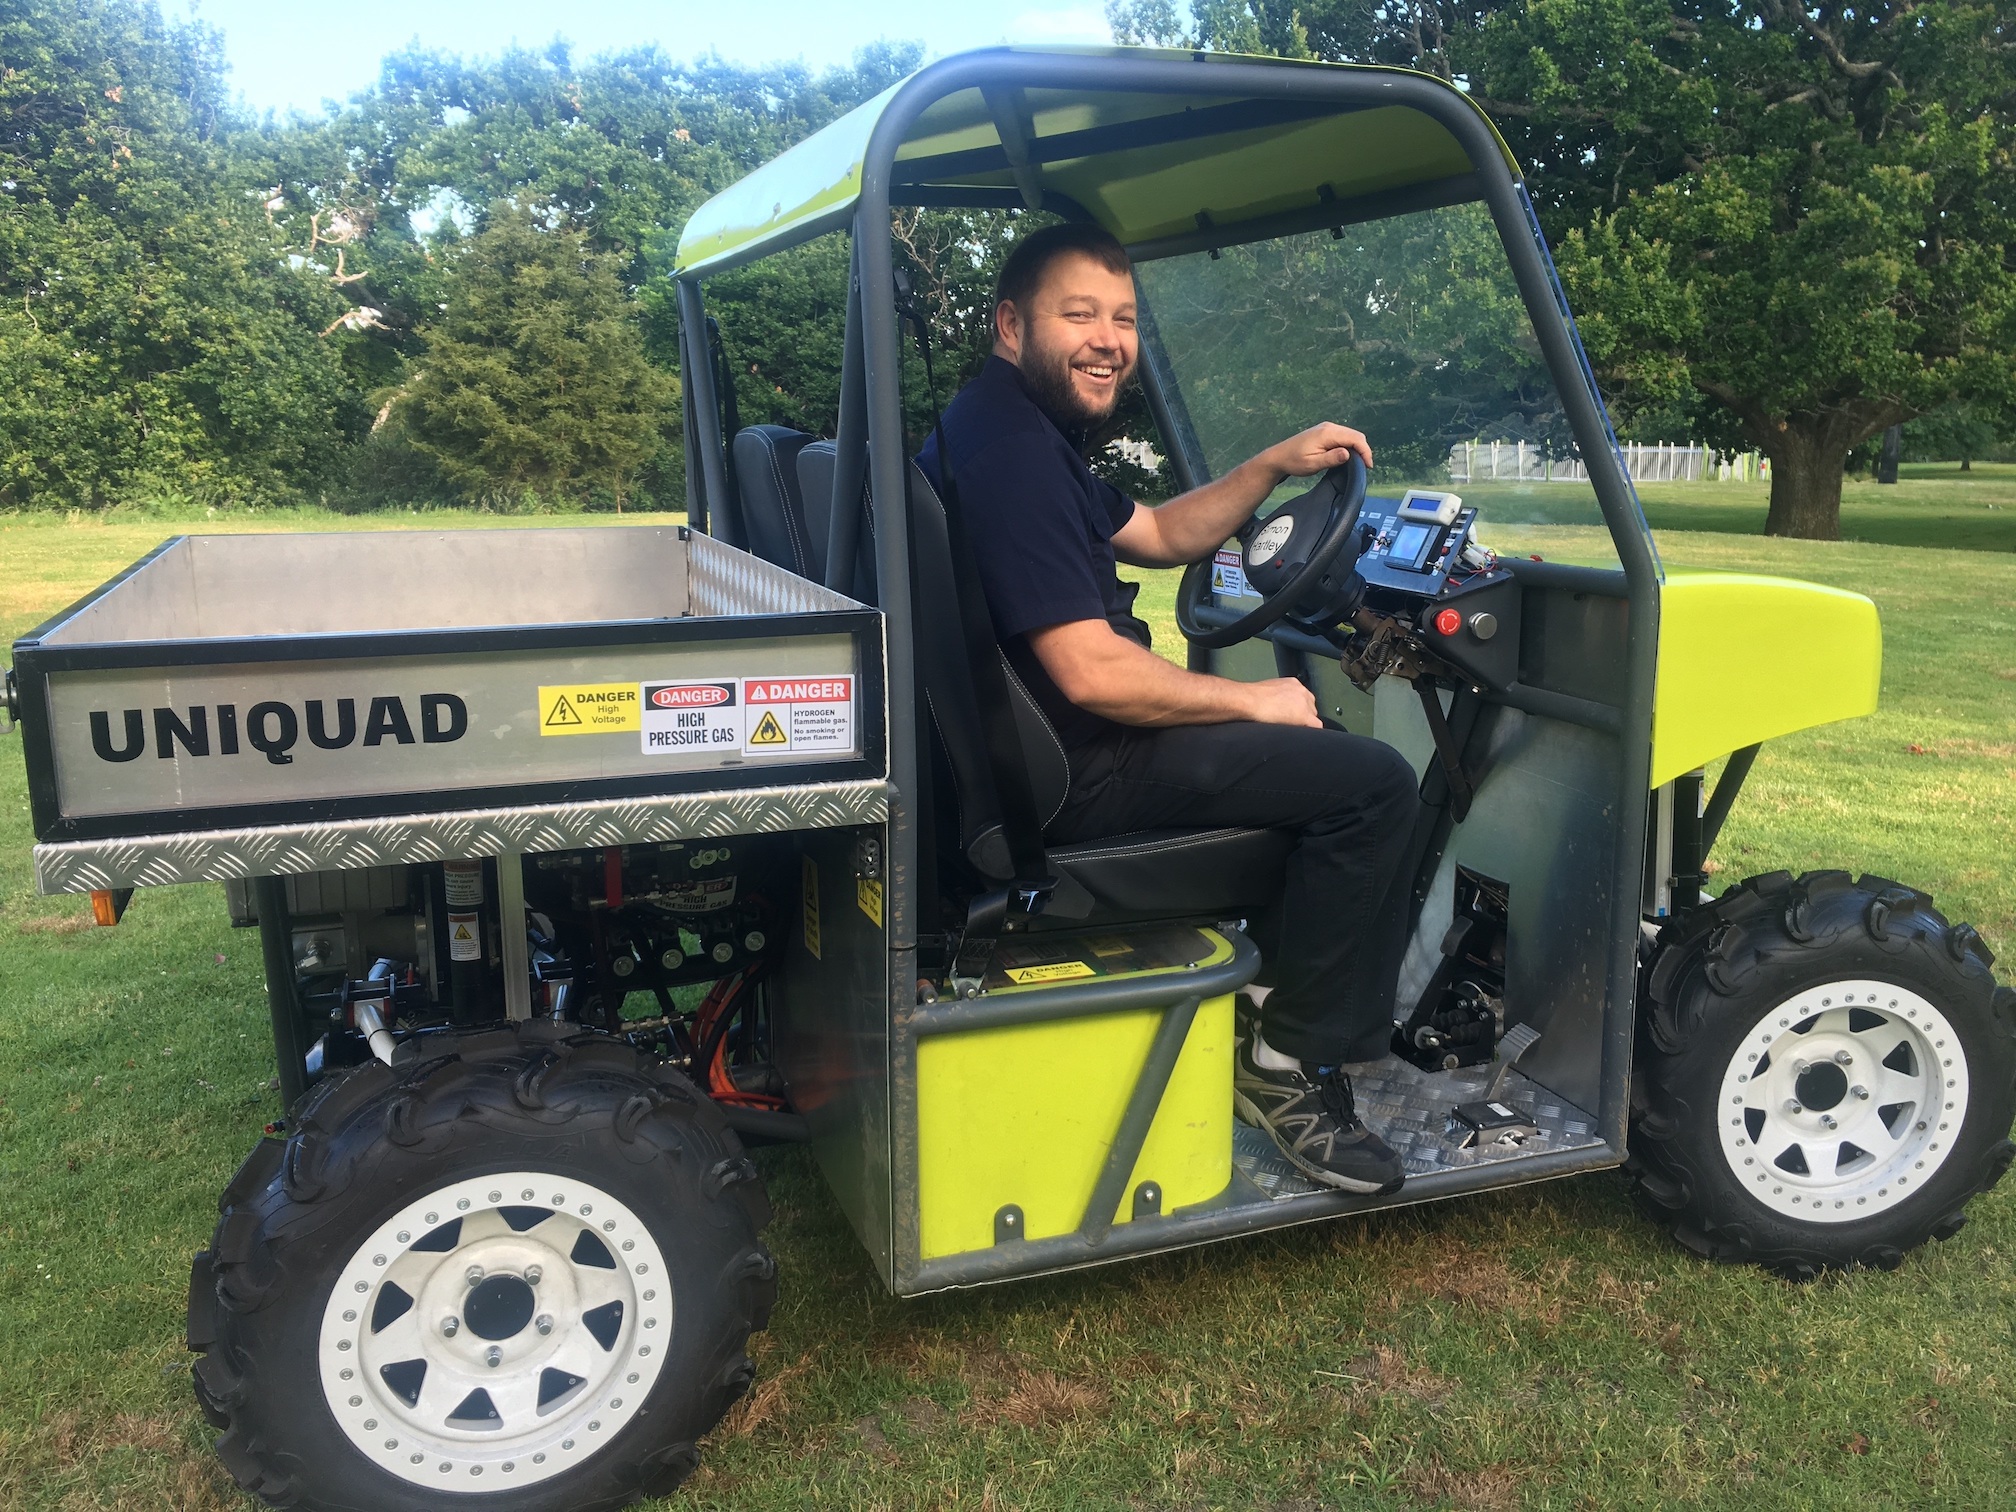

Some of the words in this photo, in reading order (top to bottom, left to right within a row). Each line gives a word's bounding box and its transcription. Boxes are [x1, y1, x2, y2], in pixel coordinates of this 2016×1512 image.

[1252, 540, 1282, 553] Hartley
[1219, 553, 1240, 566] DANGER
[577, 691, 636, 703] DANGER
[660, 689, 722, 704] DANGER
[770, 682, 846, 700] DANGER
[598, 705, 619, 714] High
[794, 709, 835, 717] HYDROGEN
[591, 715, 626, 724] Voltage
[677, 712, 705, 728] HIGH
[89, 693, 468, 765] UNIQUAD
[649, 729, 709, 746] PRESSURE
[712, 727, 734, 743] GAS
[659, 900, 707, 910] PRESSURE
[710, 899, 728, 908] GAS
[683, 895, 707, 903] HIGH
[1036, 964, 1082, 972] DANGER
